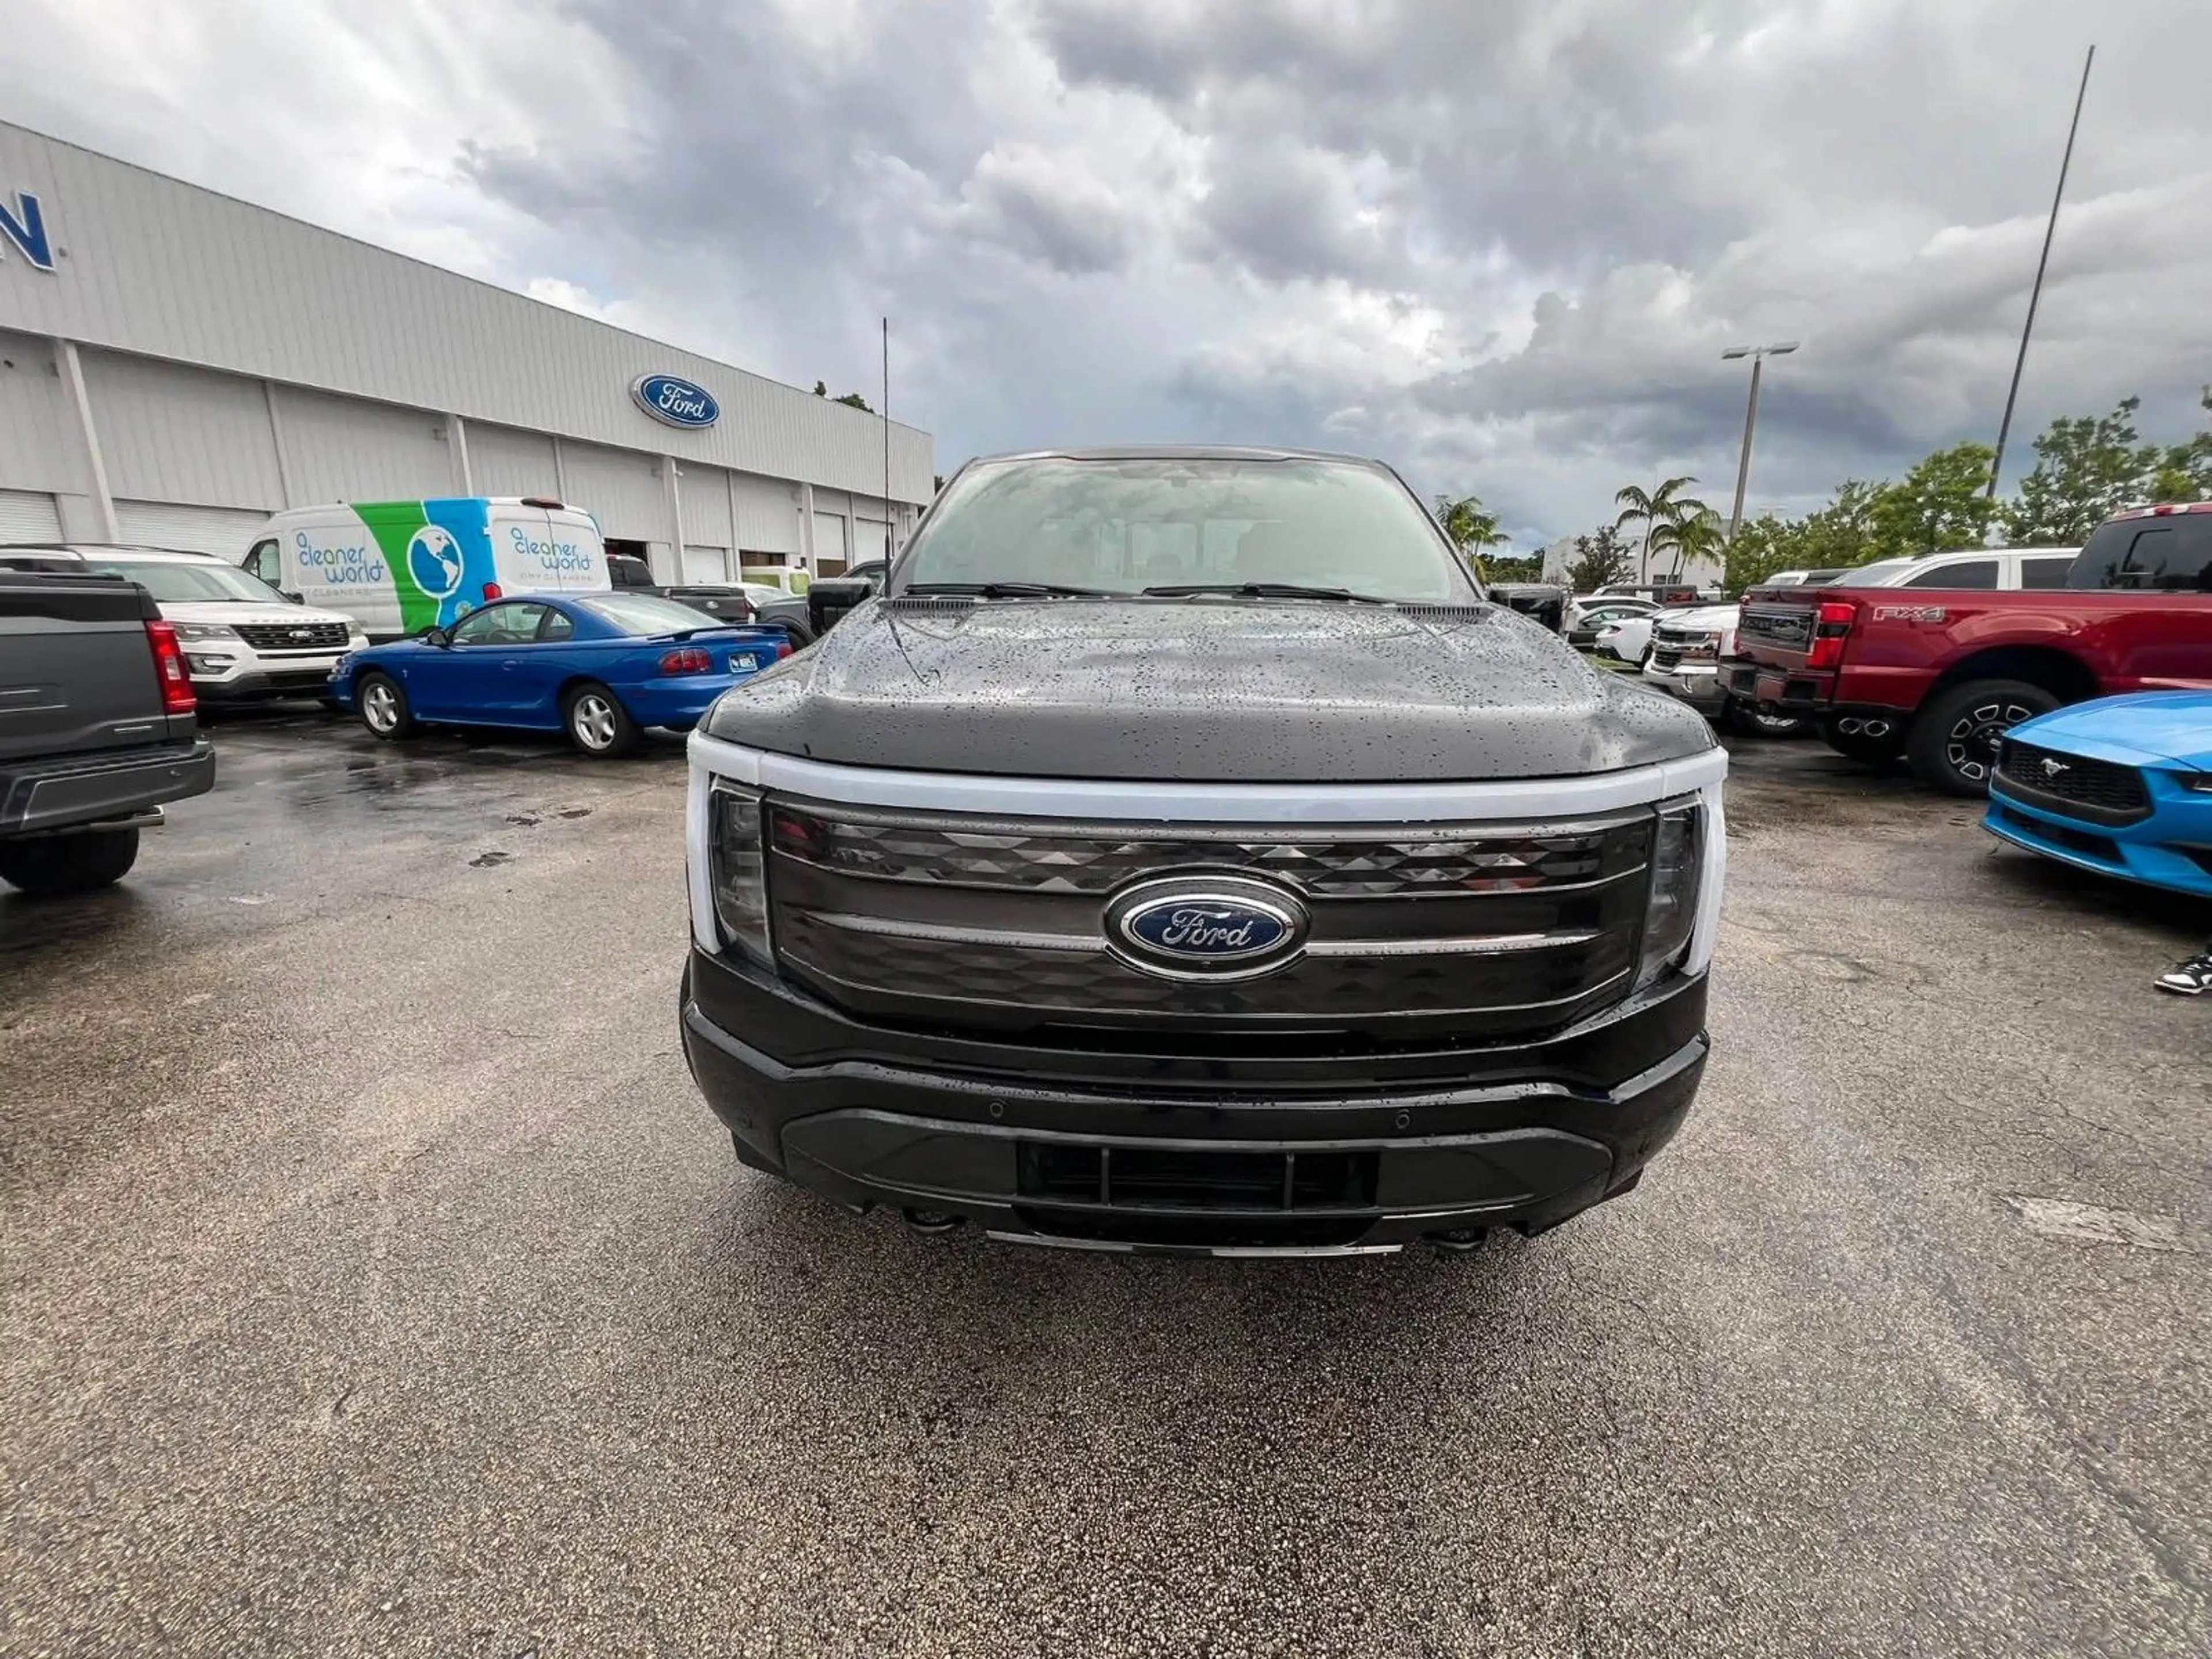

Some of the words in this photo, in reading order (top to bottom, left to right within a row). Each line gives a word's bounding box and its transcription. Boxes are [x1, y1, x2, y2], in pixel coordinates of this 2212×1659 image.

[659, 382, 706, 418] Ford
[299, 545, 365, 566] cleaner
[514, 537, 577, 556] cleaner
[324, 559, 384, 583] world
[541, 554, 592, 571] world
[1873, 607, 1946, 622] FX4
[1161, 908, 1254, 946] Ford
